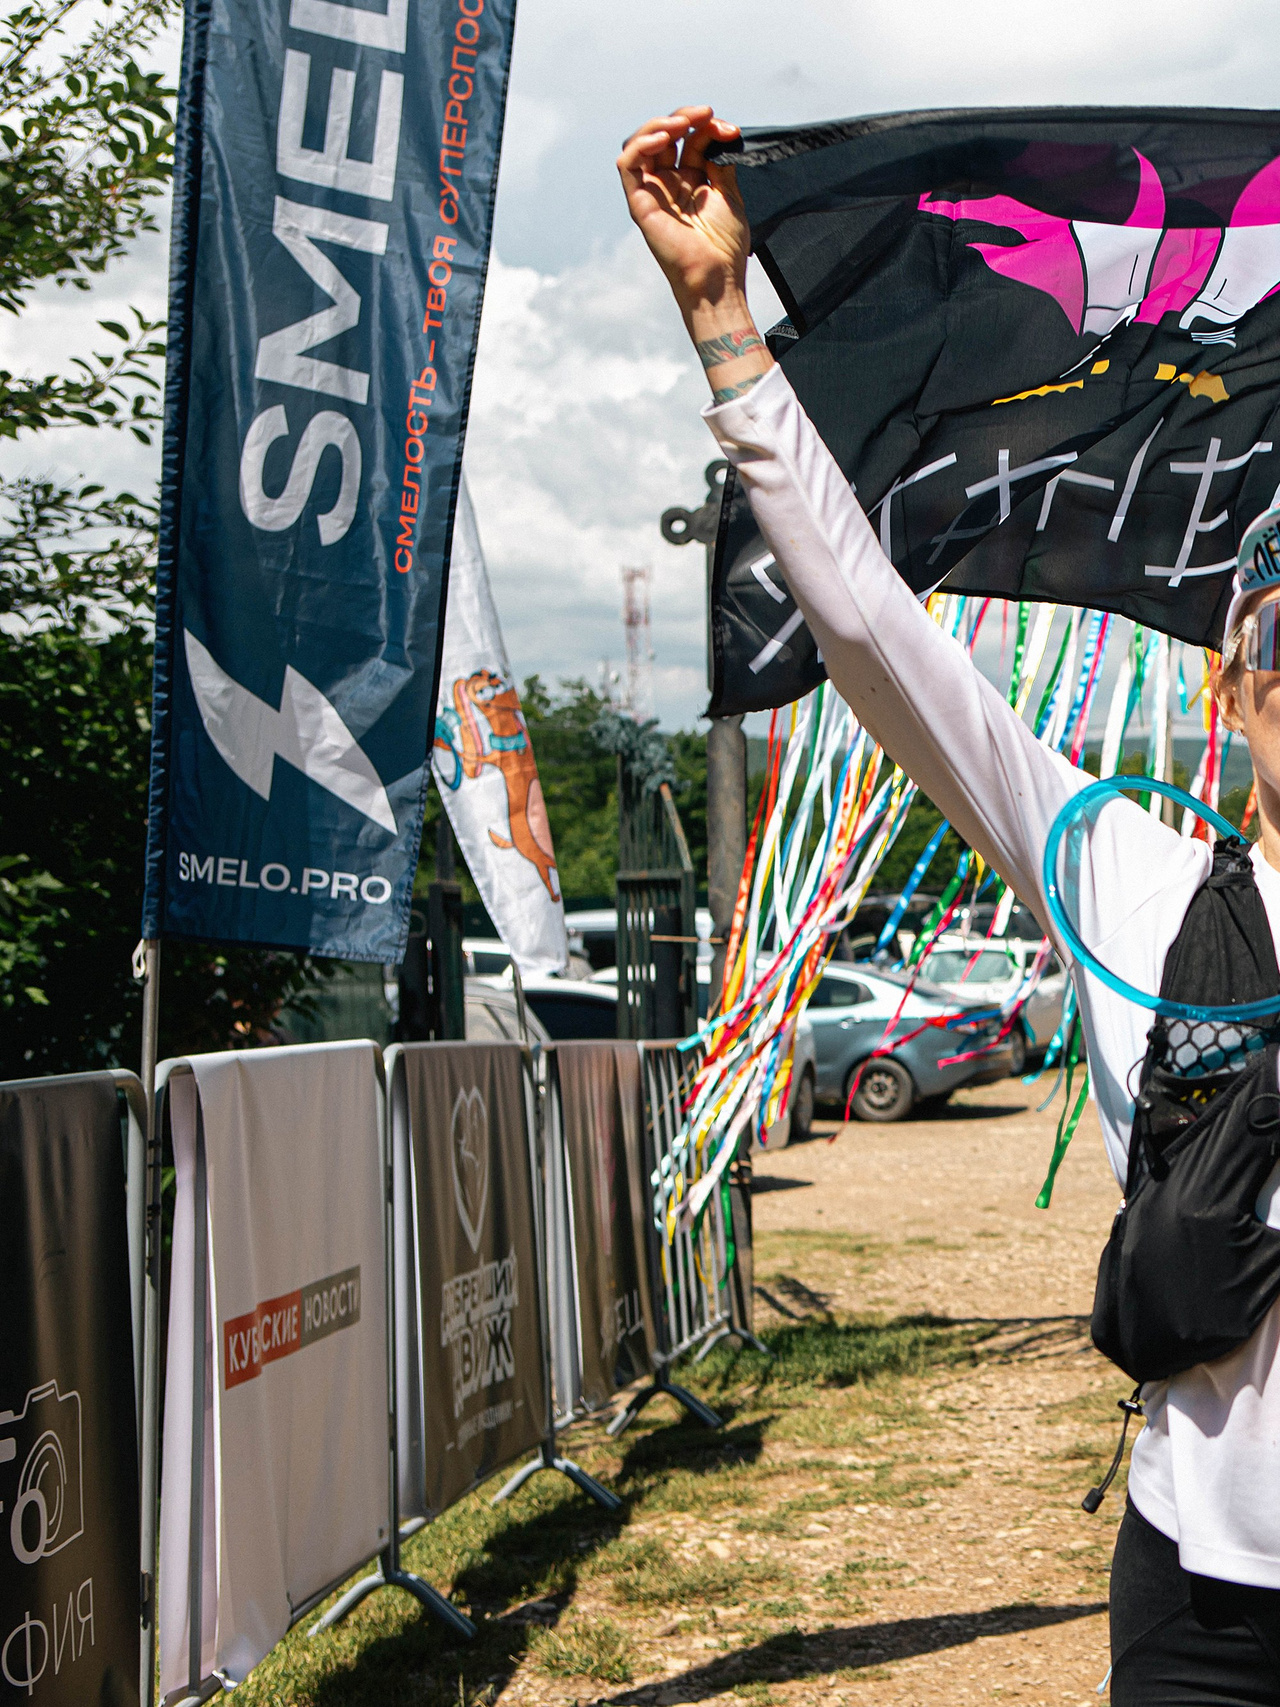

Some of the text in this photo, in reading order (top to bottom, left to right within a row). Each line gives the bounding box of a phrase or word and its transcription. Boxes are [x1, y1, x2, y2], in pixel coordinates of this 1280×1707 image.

[395, 367, 437, 574] СМЕЛОСТЬ
[423, 235, 458, 334] ТВОЯ
[178, 851, 393, 905] SMELO.PRO
